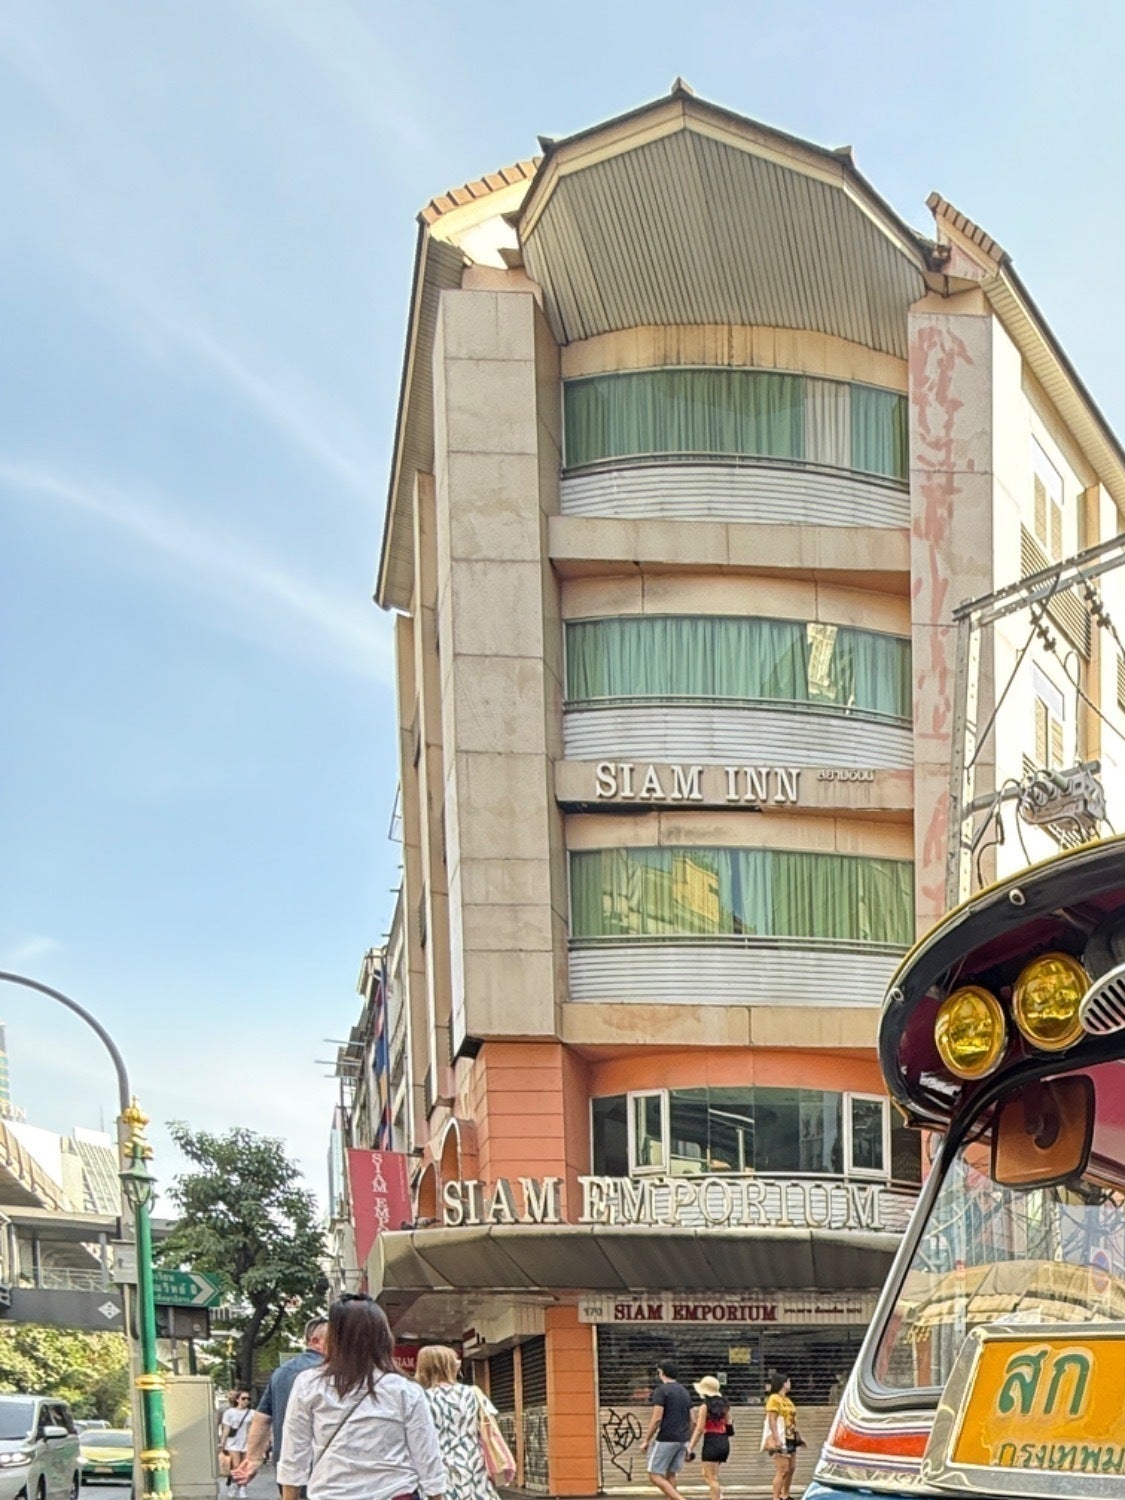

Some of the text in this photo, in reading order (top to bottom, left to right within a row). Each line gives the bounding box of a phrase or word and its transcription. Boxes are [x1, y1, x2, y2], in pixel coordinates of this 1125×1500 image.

[595, 762, 801, 802] SIAM INN
[371, 1152, 388, 1193] SIAM
[443, 1175, 563, 1226] SIAM
[577, 1175, 885, 1230] EMPORIUM
[614, 1303, 664, 1321] SIAM
[672, 1304, 778, 1322] EMPORIUM
[999, 1350, 1091, 1416] สก
